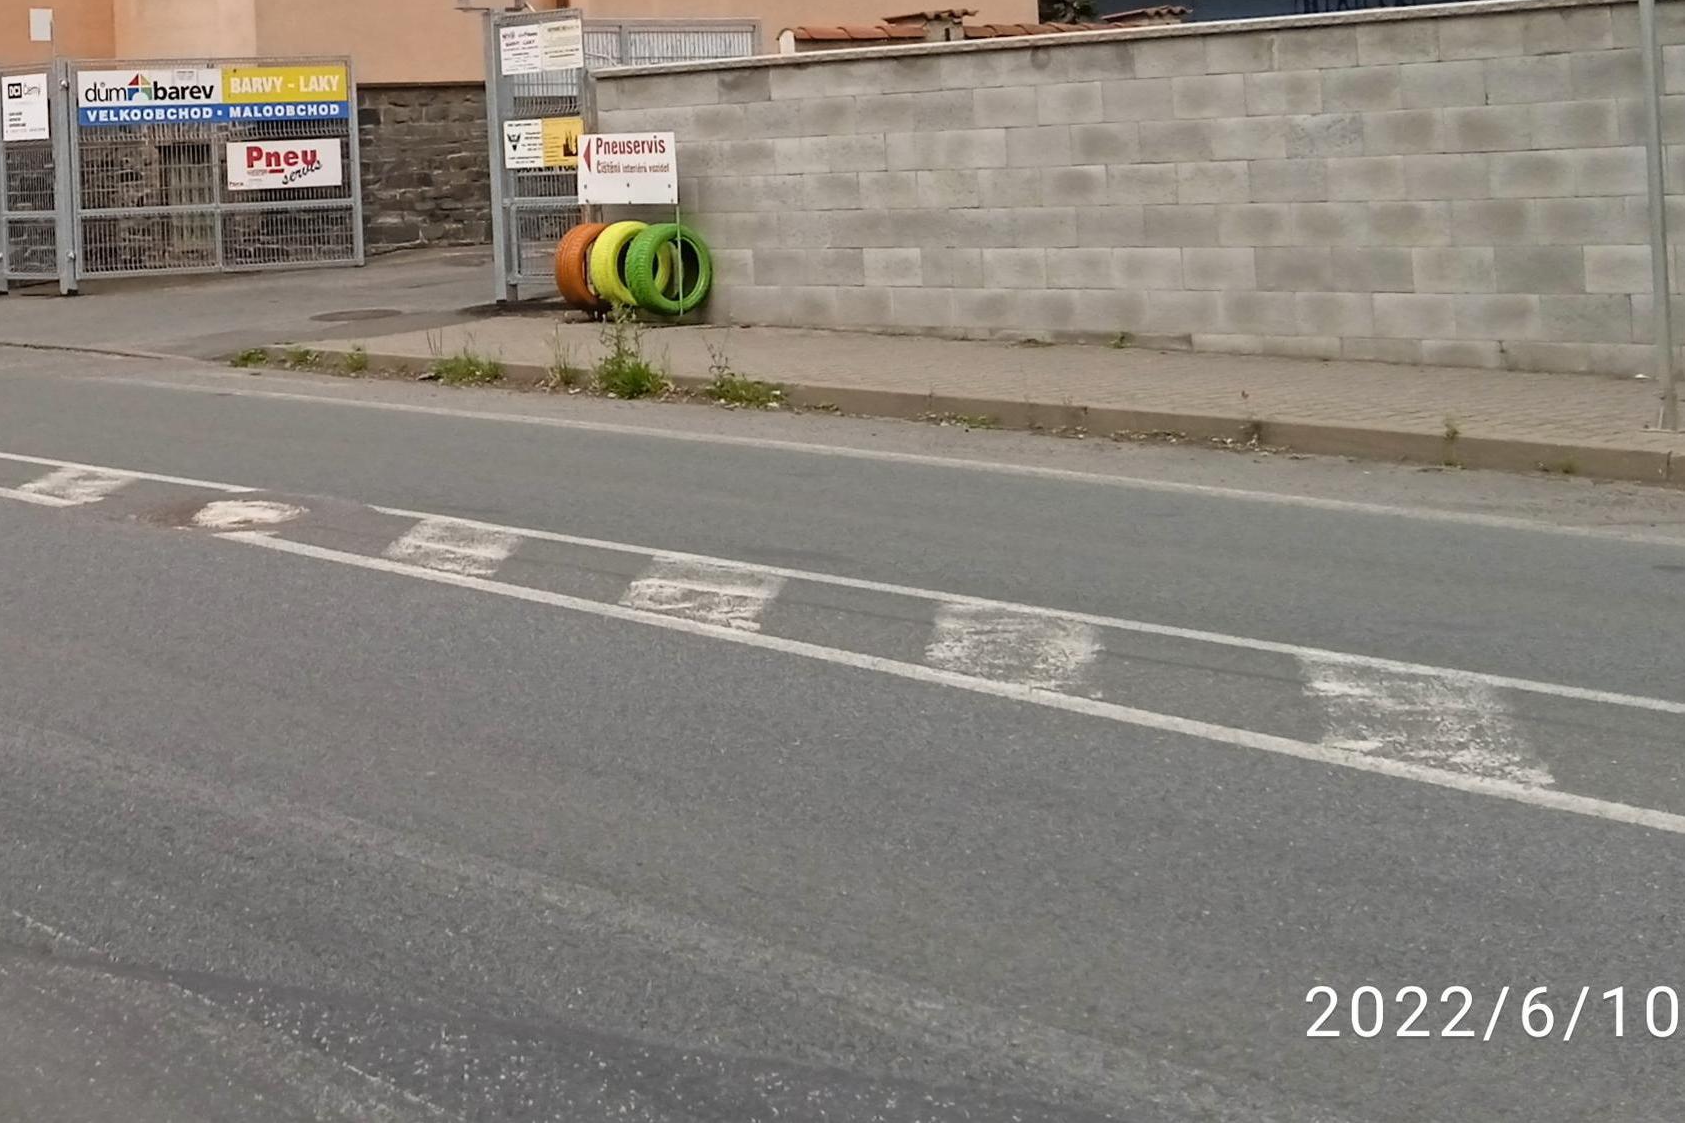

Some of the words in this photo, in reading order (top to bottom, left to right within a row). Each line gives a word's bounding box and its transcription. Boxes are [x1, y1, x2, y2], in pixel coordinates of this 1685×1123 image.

[85, 82, 127, 102] dům
[152, 81, 214, 101] barev
[230, 76, 284, 94] BARVY
[299, 74, 340, 92] LAKY
[87, 107, 213, 122] VELKOOBCHOD
[229, 104, 340, 119] MALOOBCHOD
[596, 136, 666, 155] Pneuservis
[246, 146, 317, 168] Pneu
[282, 160, 323, 185] servis
